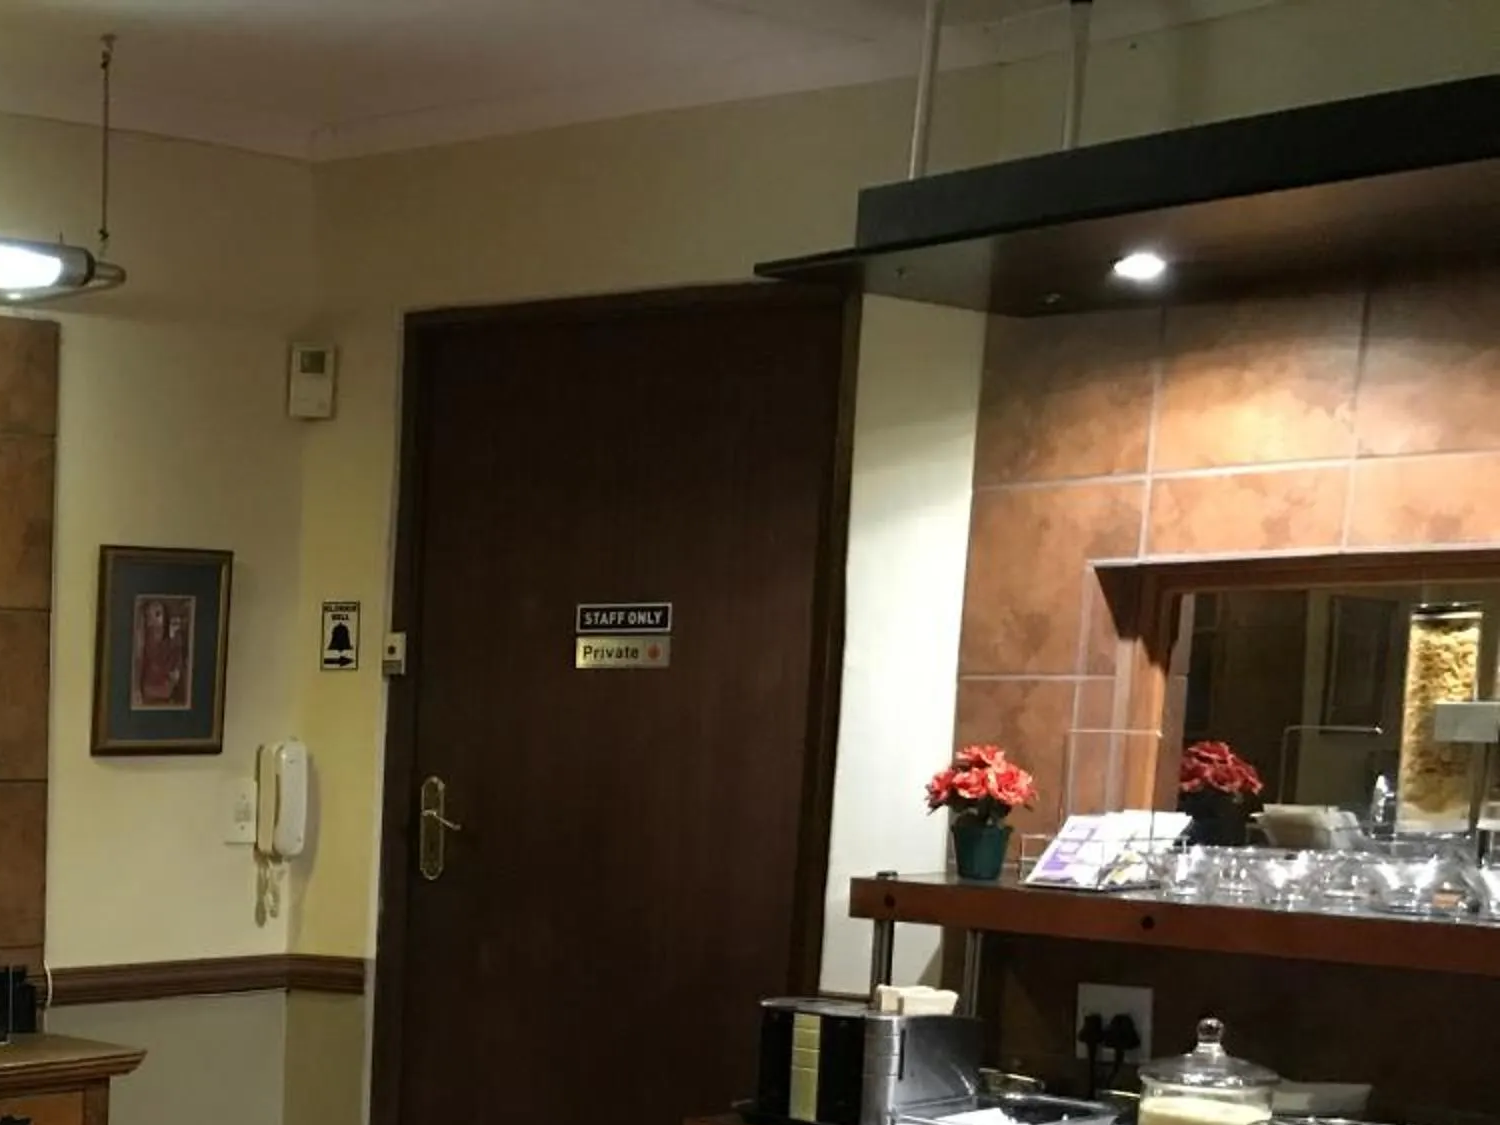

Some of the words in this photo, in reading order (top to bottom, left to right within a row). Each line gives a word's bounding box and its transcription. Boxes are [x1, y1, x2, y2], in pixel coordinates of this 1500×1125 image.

[584, 611, 625, 625] STAFF
[628, 610, 662, 625] ONLY
[582, 645, 639, 660] Private
